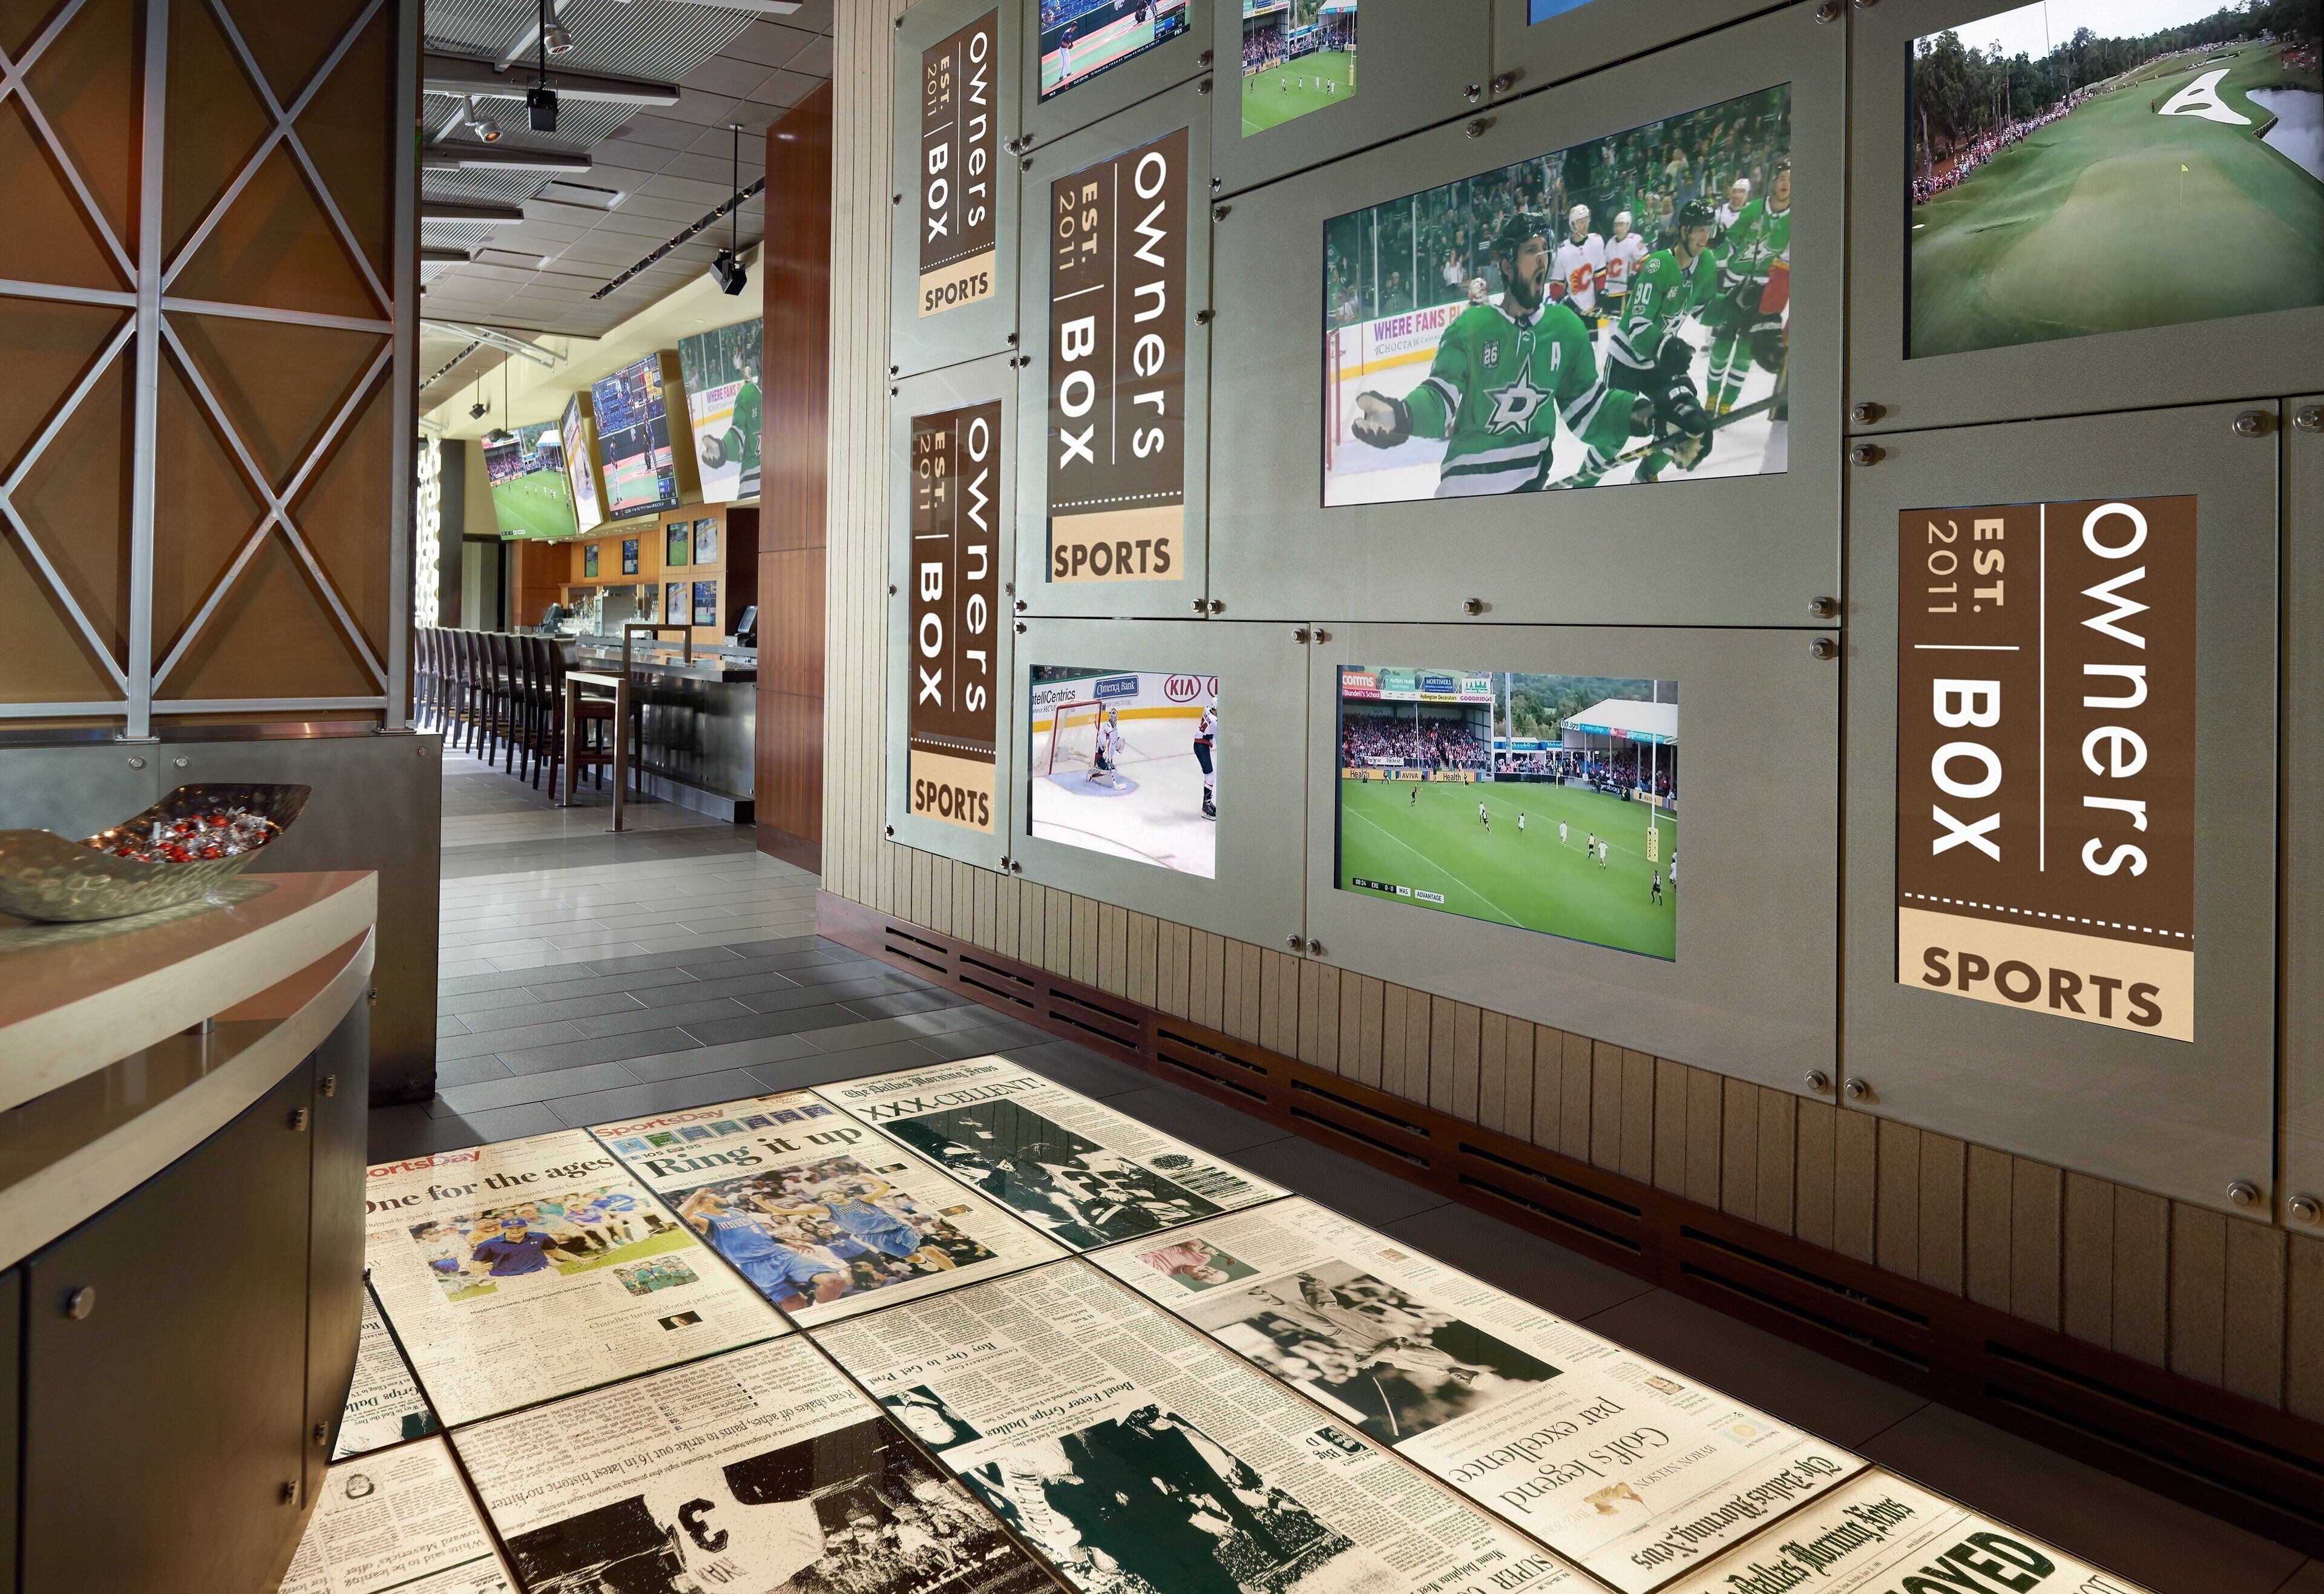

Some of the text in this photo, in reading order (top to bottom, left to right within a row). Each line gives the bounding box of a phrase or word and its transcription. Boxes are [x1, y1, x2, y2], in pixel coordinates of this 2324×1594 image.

[927, 64, 937, 116] 2011
[940, 55, 950, 110] EST.
[928, 142, 948, 244] BOX
[1059, 191, 1075, 271] 2011
[1082, 182, 1098, 263] EST.
[925, 272, 988, 312] SPORTS
[1374, 309, 1445, 341] WHERE FANS
[1379, 338, 1420, 354] CHOCTAW
[1484, 346, 1497, 364] 26
[706, 383, 736, 404] WHERE FANS
[1060, 315, 1095, 471] BOX
[920, 434, 931, 510] 2011
[934, 431, 945, 508] EST.
[1054, 537, 1171, 578] SPORTS
[1927, 520, 1959, 614] 2011
[1974, 517, 2004, 613] EST.
[919, 562, 943, 708] BOX
[1120, 680, 1135, 691] Bank
[1170, 679, 1194, 695] KIA
[1443, 773, 1461, 781] Health
[1931, 677, 2003, 864] BOX
[915, 778, 989, 827] SPORTS
[1355, 878, 1367, 887] 08:24
[1416, 891, 1442, 902] ADVANTAGE
[1921, 945, 2164, 1028] SPORTS
[842, 1063, 999, 1098] The Dallas Morning News
[856, 1077, 1046, 1121] XXX-CELLENT!
[525, 1136, 557, 1145] Seasoned
[594, 1109, 724, 1137] SportsDay
[638, 1127, 862, 1178] Ring it up
[425, 1156, 615, 1202] for the ages
[657, 1178, 699, 1192] Mavericks
[407, 1189, 548, 1221] Spieth historic Augusta
[589, 1307, 663, 1329] Chandler turning
[1053, 1309, 1078, 1322] Counting
[867, 1340, 997, 1386] Roy Orr to Get Post
[942, 1348, 1018, 1374] Commissioners Court
[369, 1384, 387, 1393] Cling
[382, 1386, 420, 1401] Grips
[1051, 1389, 1076, 1401] Deserted
[1076, 1382, 1095, 1392] Nearly
[1095, 1376, 1115, 1386] Streets
[1504, 1390, 1537, 1407] tournament
[985, 1381, 1135, 1437] Bowl Fever Grips Dallas
[1012, 1403, 1029, 1414] Cling
[1452, 1395, 1554, 1444] regarded modern
[1553, 1400, 1574, 1415] straight
[490, 1388, 856, 1511] Ryan shakes off aches, pains to strike out 16 in latest historic no-hitter
[681, 1402, 868, 1464] Nolan Wednesday
[1013, 1417, 1091, 1449] Super Way End Day
[1305, 1437, 1321, 1446] D
[1448, 1395, 1626, 1483] par excellence
[1312, 1448, 1342, 1460] Big
[1498, 1427, 1669, 1515] Golf's legend
[1633, 1443, 1717, 1490] BYRON NELSON
[1794, 1455, 1843, 1479] The
[1747, 1468, 1816, 1507] Dallas
[441, 1529, 480, 1546] toward
[1672, 1494, 1770, 1546] Morning
[1779, 1495, 1919, 1578] Morning News
[344, 1540, 484, 1589] White said to be leaning
[377, 1543, 438, 1567] Mavericks'
[1437, 1548, 1507, 1584] Miami Dolphins
[1487, 1553, 1554, 1590] SUPER
[1630, 1533, 1698, 1573] News
